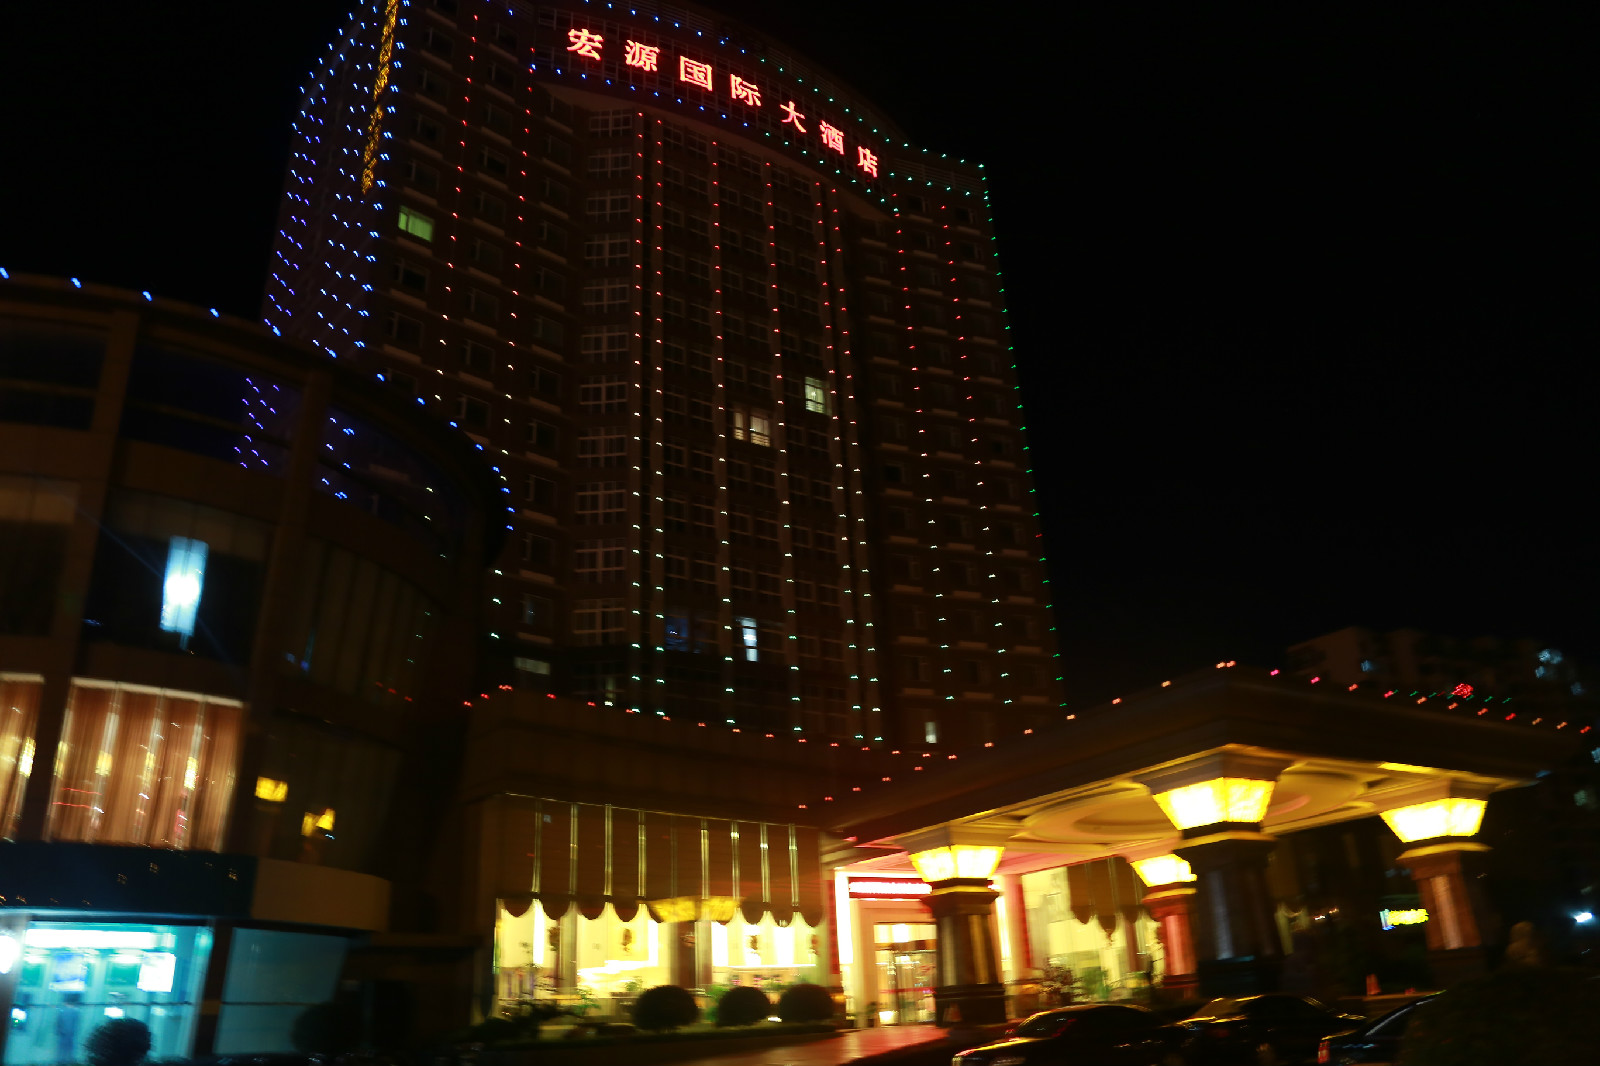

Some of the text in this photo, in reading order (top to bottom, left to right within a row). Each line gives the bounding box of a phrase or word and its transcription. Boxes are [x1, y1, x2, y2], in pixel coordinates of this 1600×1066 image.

[567, 28, 878, 178] 宏源国际大酒店
